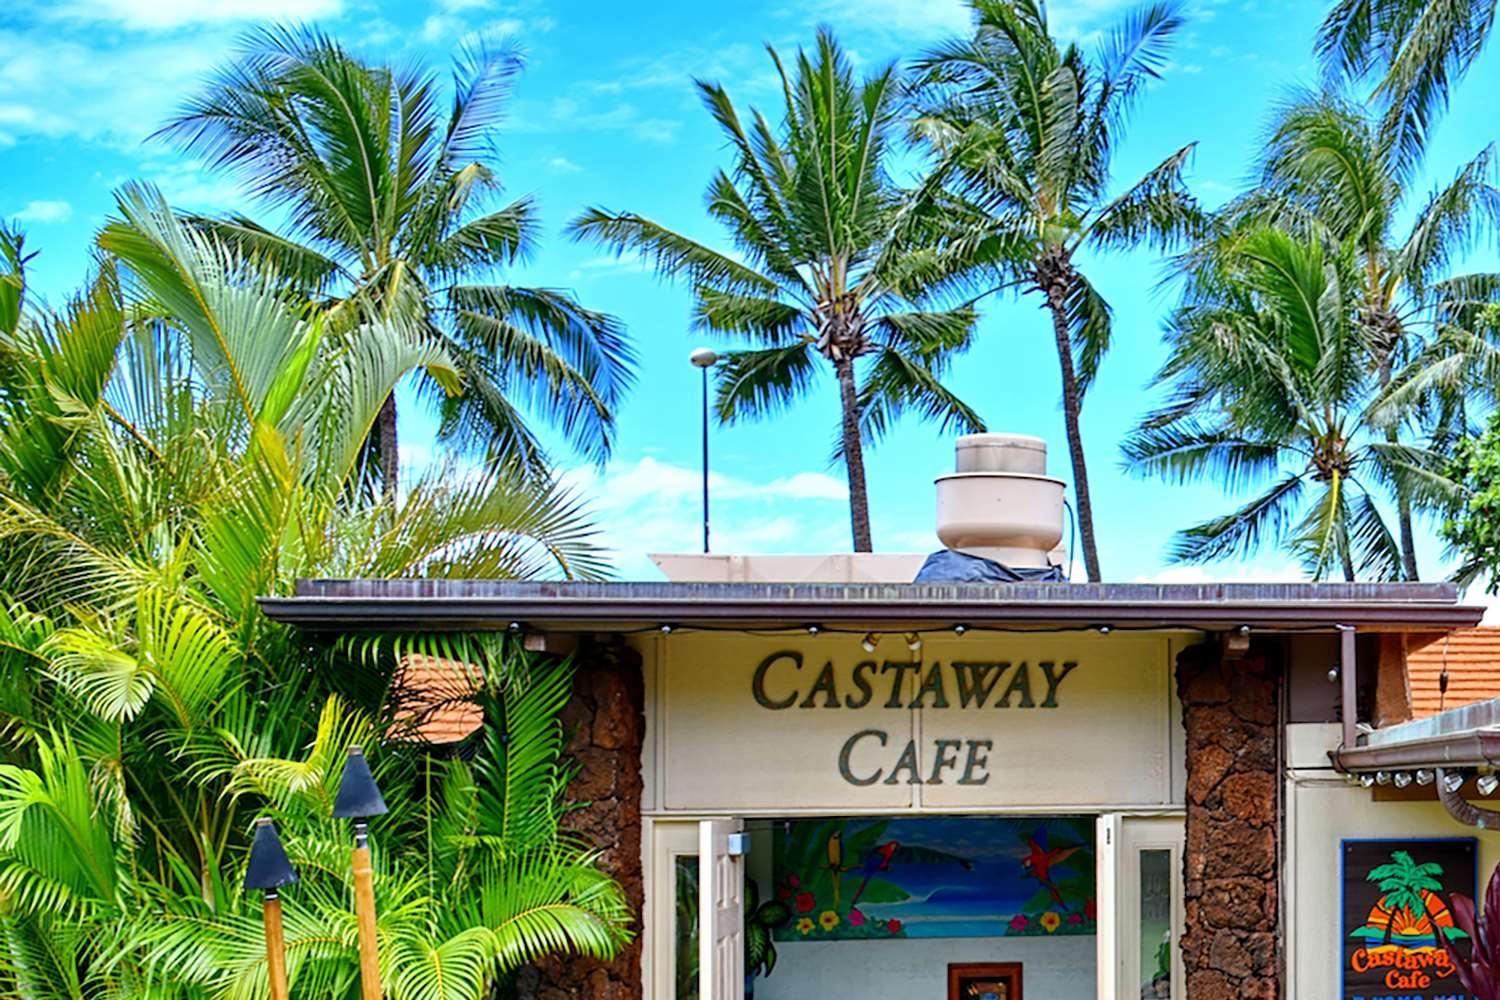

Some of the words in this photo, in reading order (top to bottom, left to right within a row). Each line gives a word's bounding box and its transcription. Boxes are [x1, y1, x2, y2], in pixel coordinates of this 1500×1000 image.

[751, 650, 1079, 710] CASTAWAY
[837, 729, 994, 787] CAFE
[1385, 969, 1431, 989] Cafe
